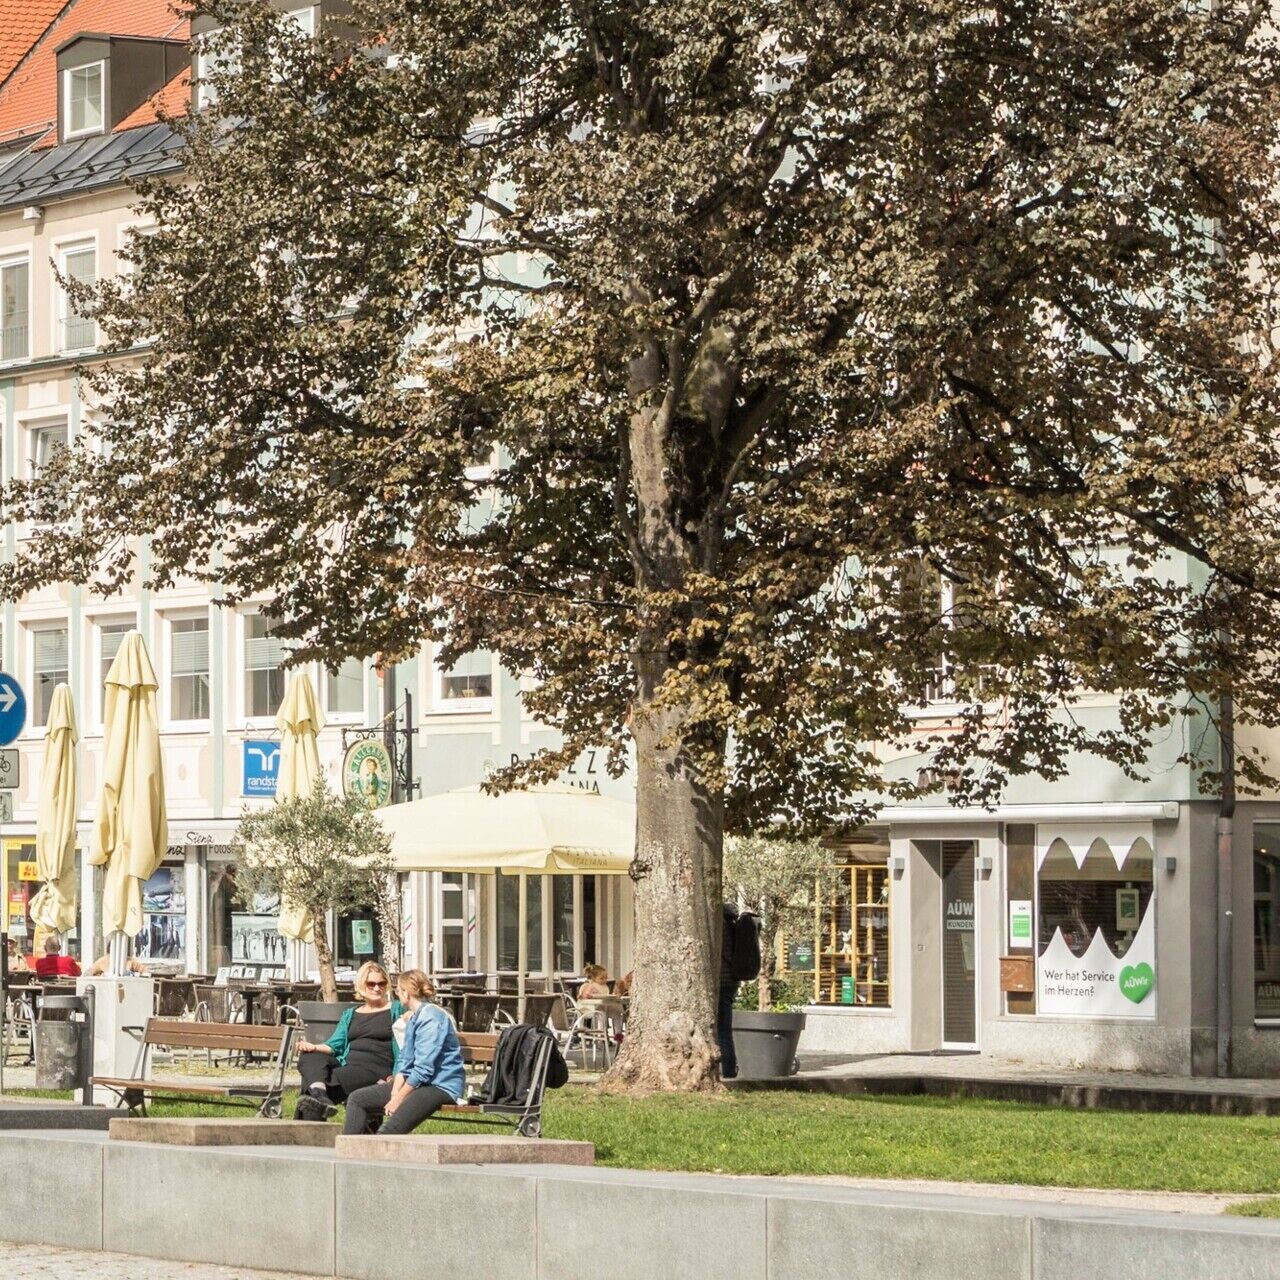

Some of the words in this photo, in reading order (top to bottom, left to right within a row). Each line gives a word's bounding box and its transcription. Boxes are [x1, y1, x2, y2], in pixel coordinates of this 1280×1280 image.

[1044, 969, 1063, 981] Wer
[1065, 969, 1080, 981] hat
[1082, 970, 1115, 982] Service
[1044, 984, 1056, 995] im
[1058, 985, 1095, 997] Herzen?
